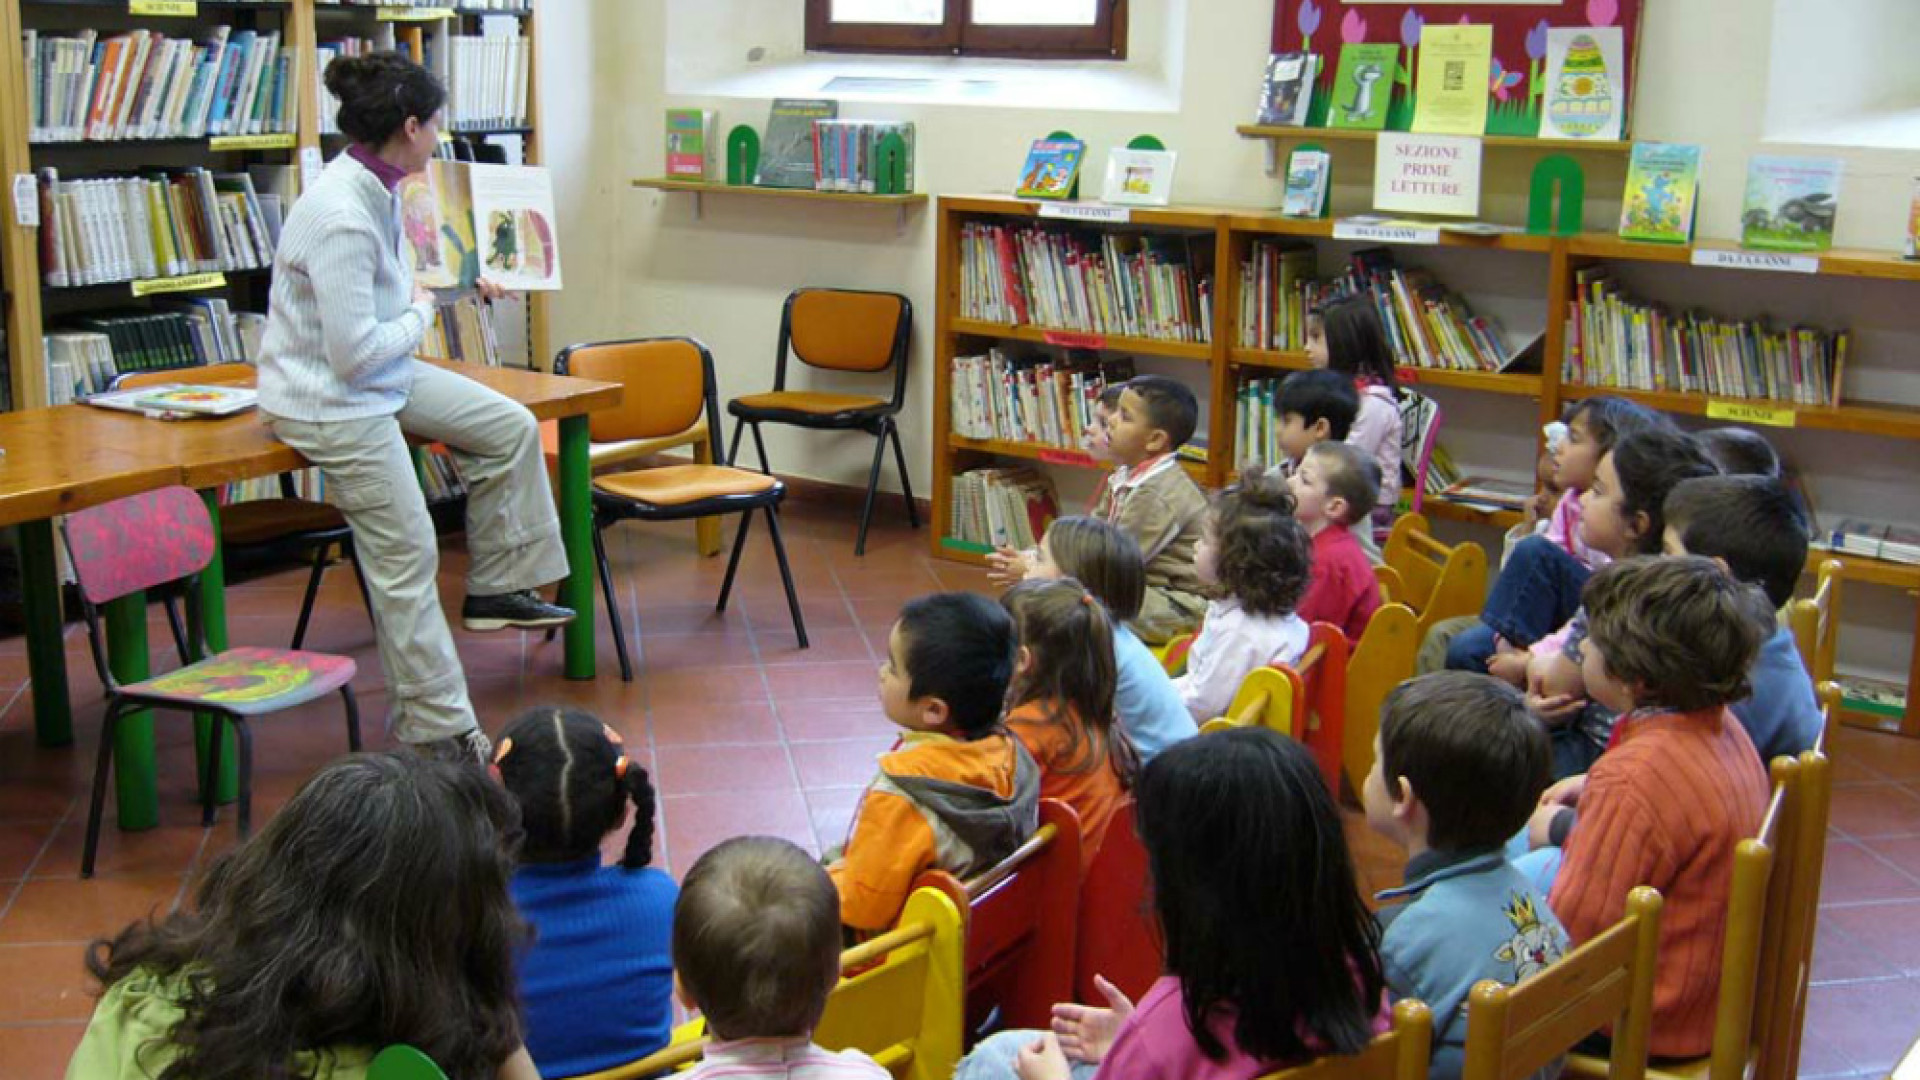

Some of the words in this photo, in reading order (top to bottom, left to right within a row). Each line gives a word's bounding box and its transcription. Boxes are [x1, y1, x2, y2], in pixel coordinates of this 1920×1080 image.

[1395, 143, 1463, 160] SEZIONE
[1403, 162, 1451, 177] PRIME
[1391, 179, 1463, 196] LETTURE
